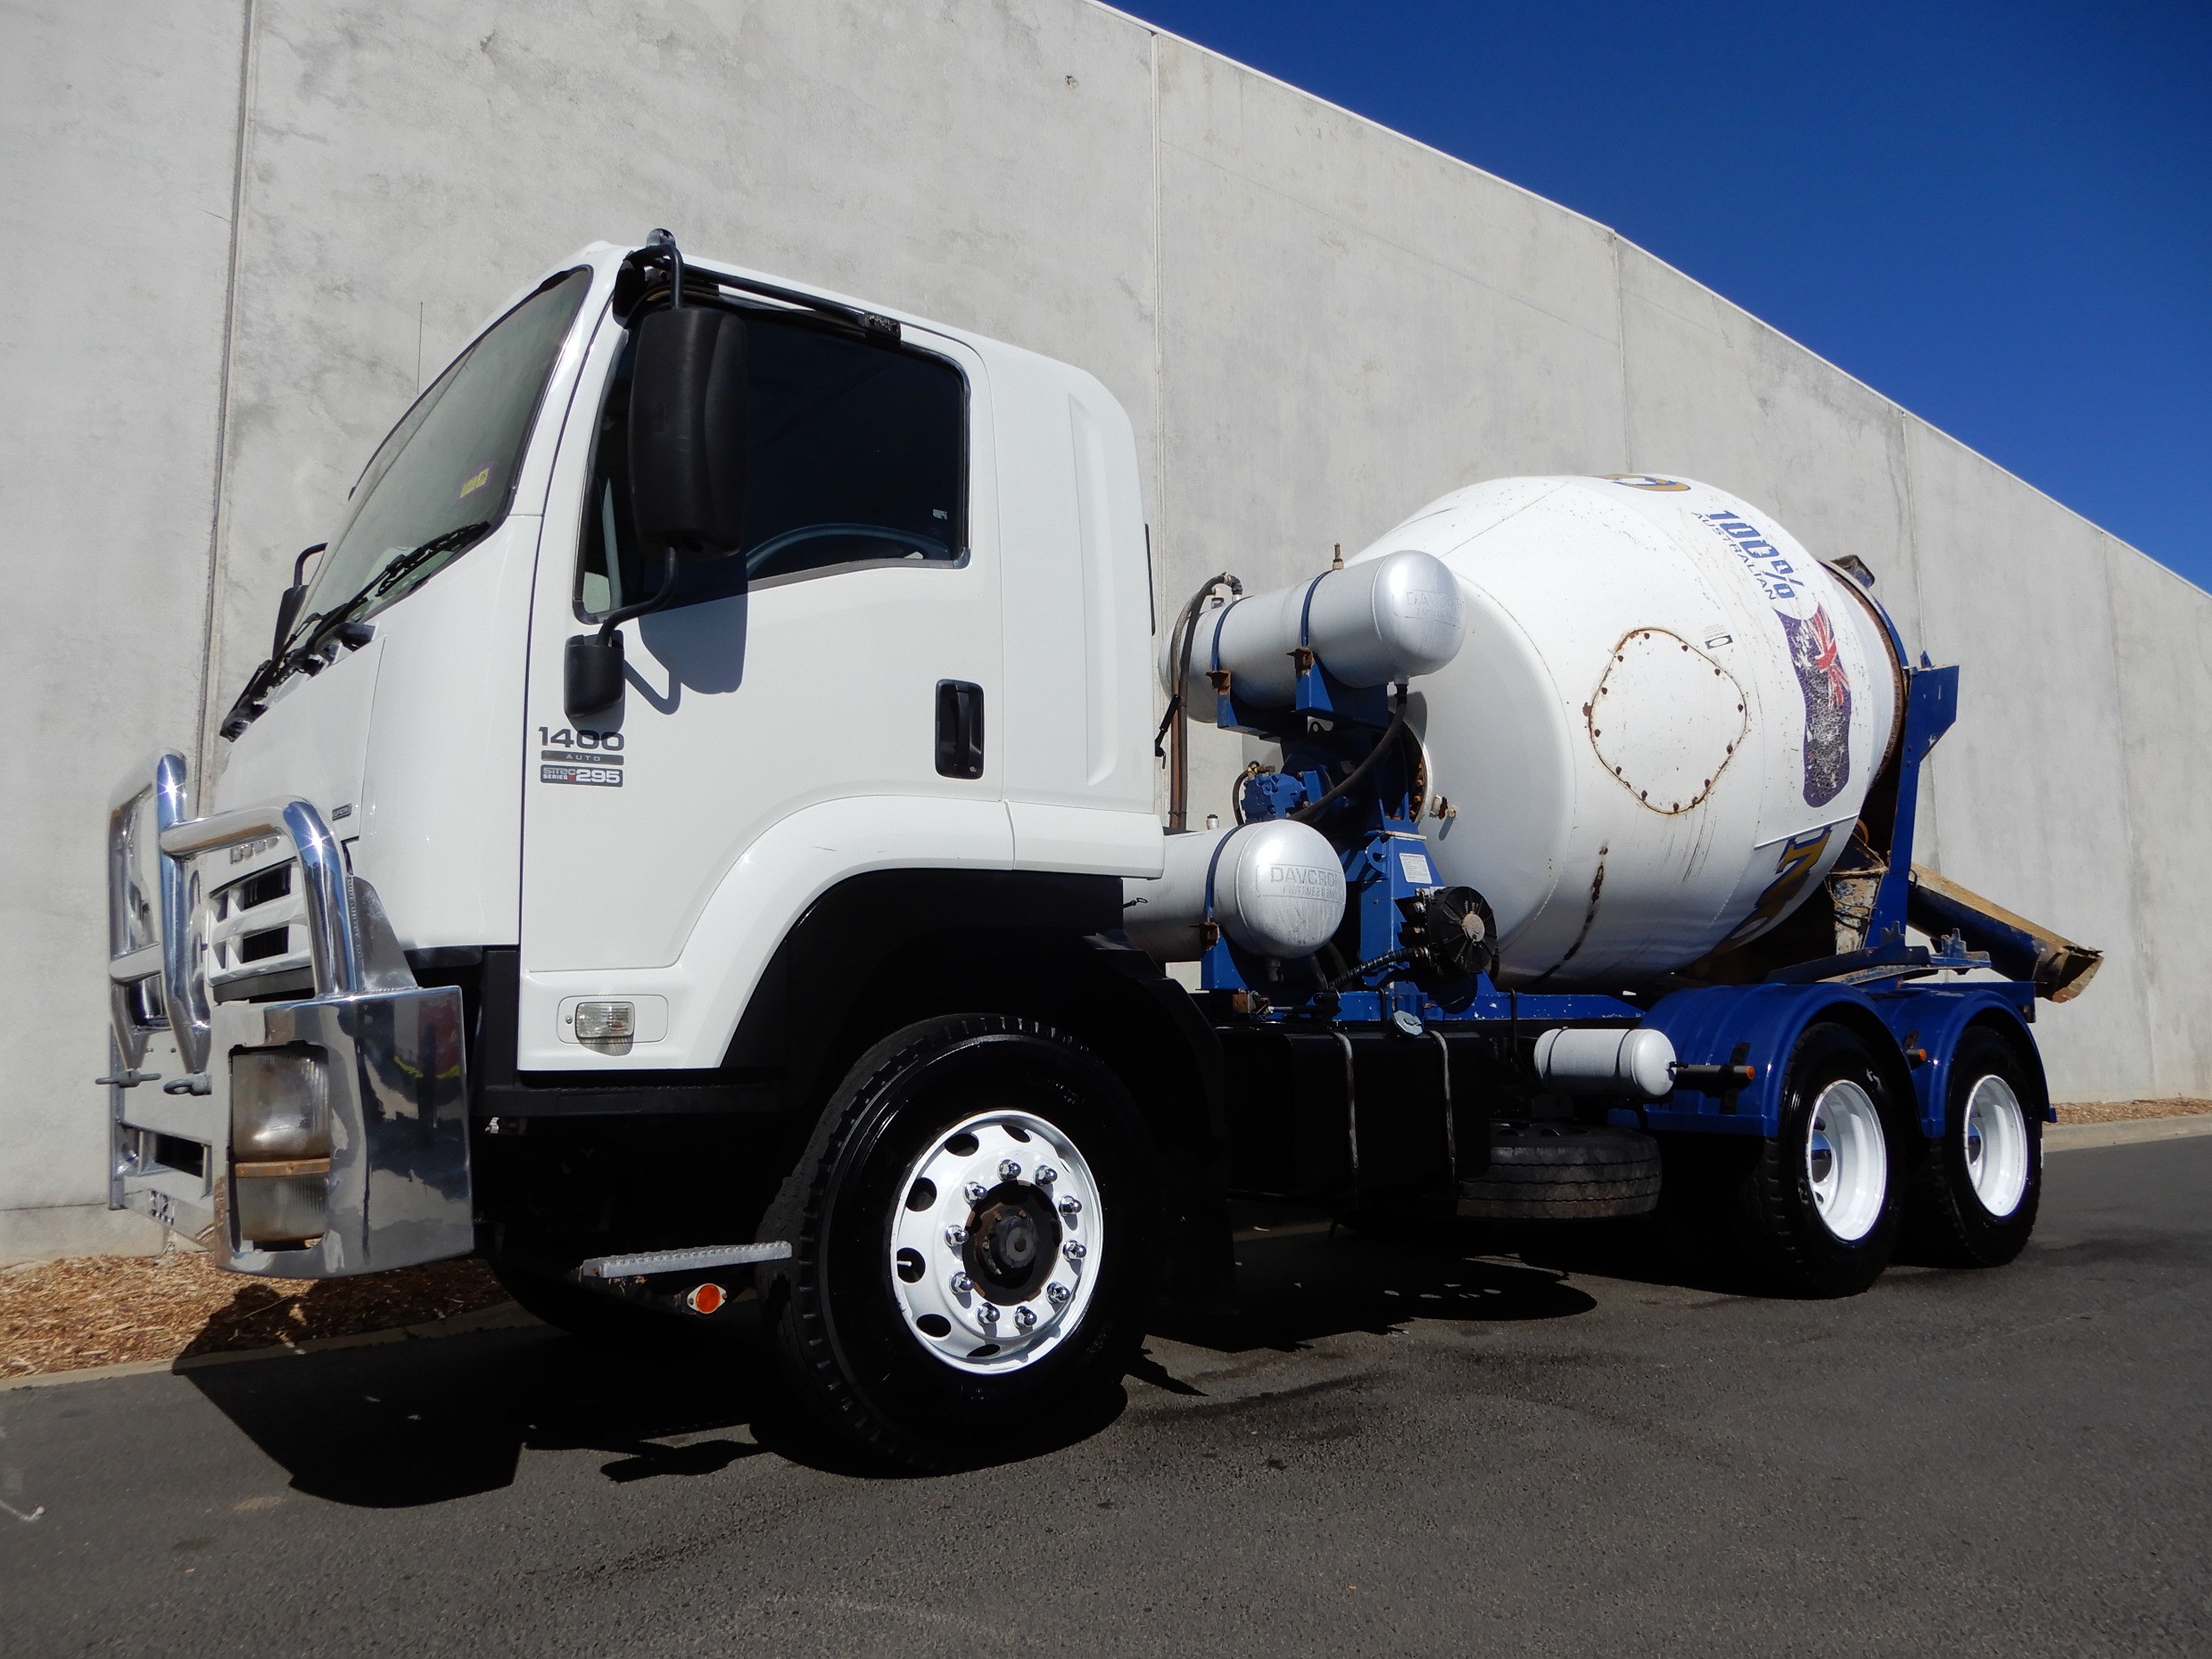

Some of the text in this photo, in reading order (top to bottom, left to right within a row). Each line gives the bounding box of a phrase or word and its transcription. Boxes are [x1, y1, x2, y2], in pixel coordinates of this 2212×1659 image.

[1690, 511, 1777, 600] AUSTRALIAN
[1709, 509, 1804, 598] 100%
[538, 726, 624, 751] 1400
[565, 751, 601, 762] AUTO
[575, 769, 621, 783] 295
